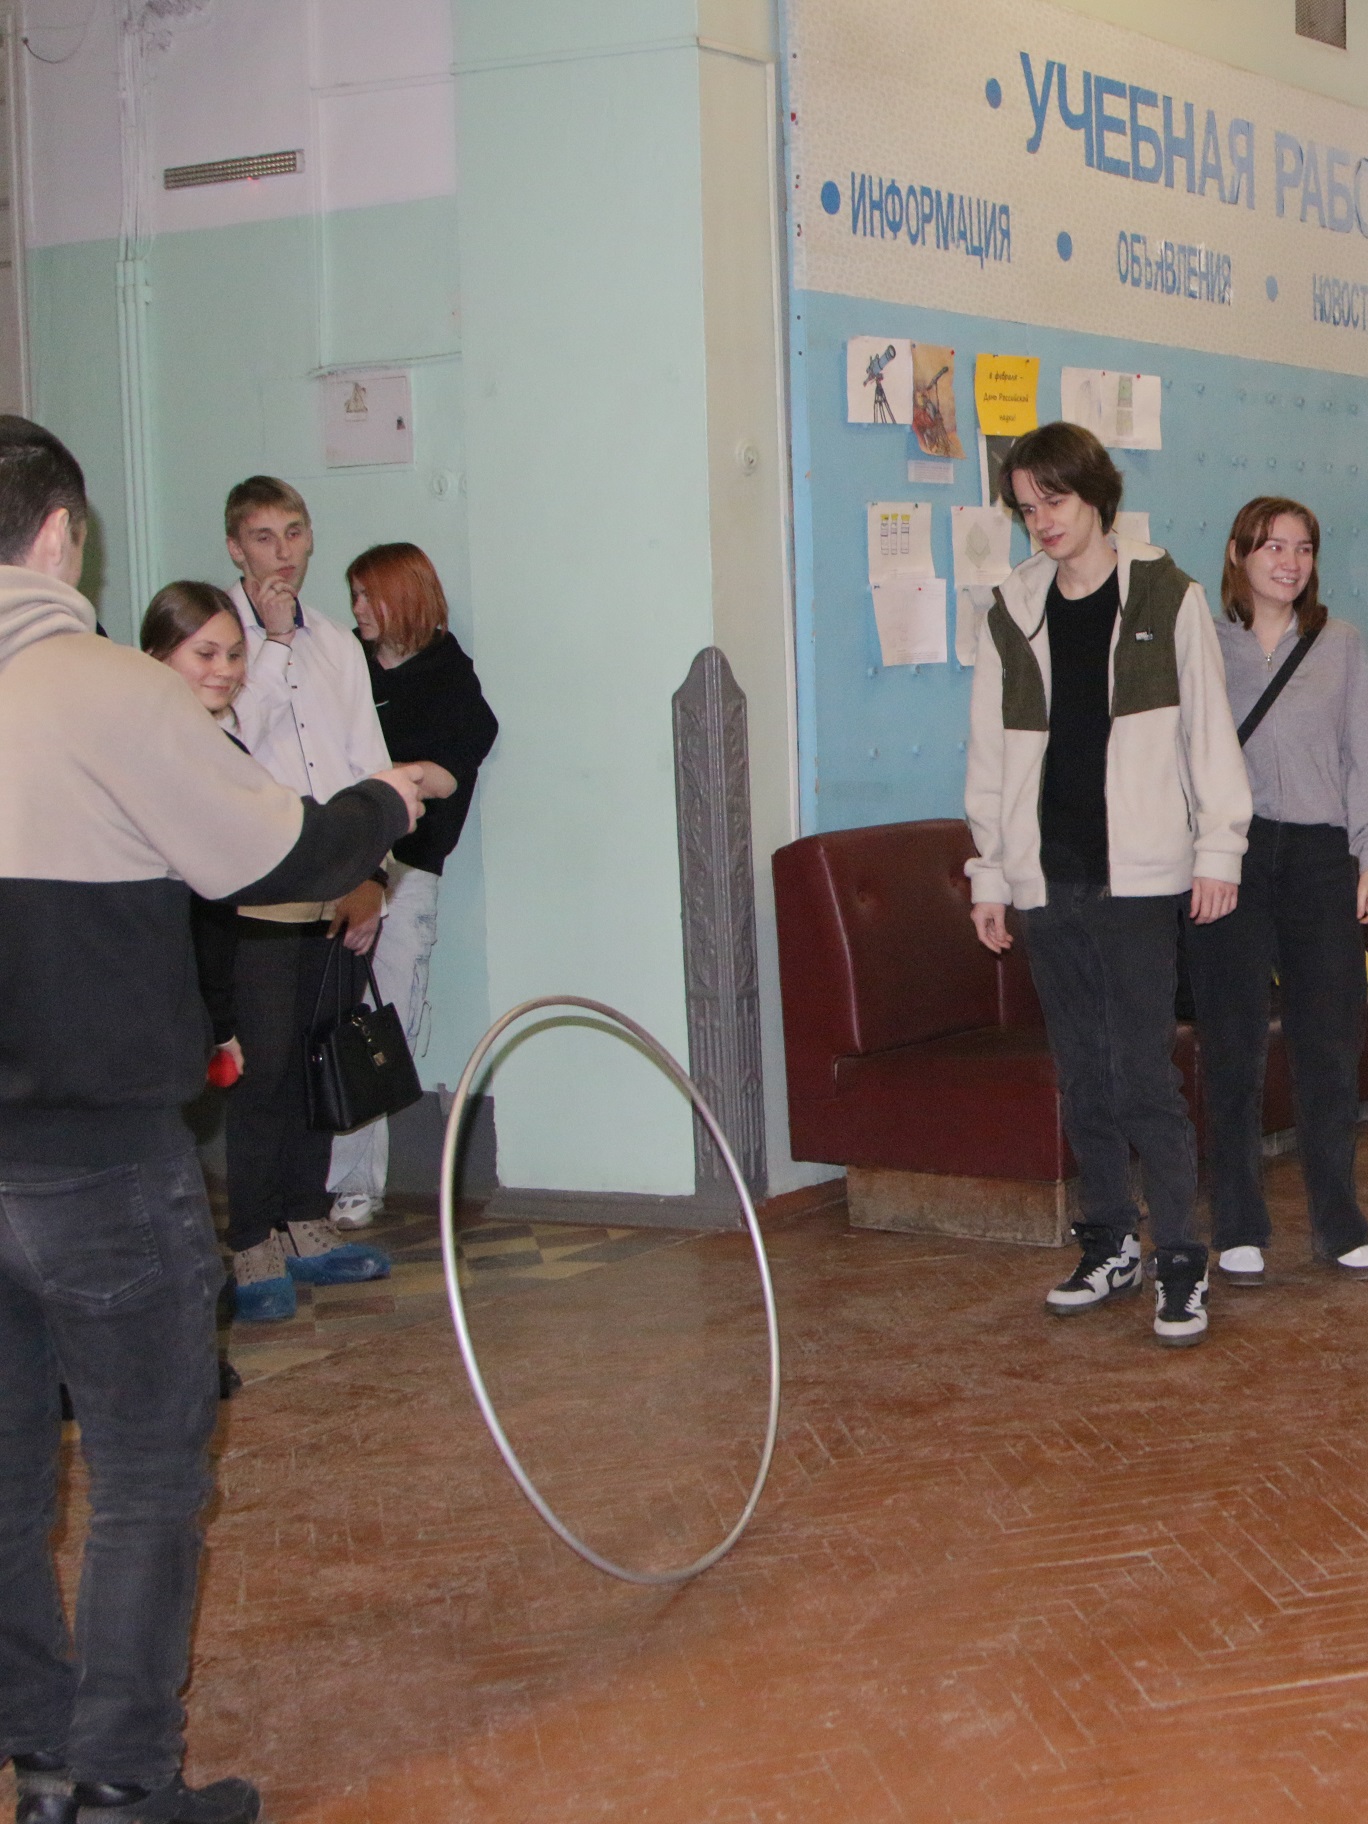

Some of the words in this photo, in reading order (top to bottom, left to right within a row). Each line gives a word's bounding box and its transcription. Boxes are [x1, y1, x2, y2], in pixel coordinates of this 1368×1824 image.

[1019, 51, 1256, 211] УЧЕБНАЯ
[850, 171, 1012, 270] ИНФОРМАЦИЯ
[1117, 230, 1232, 306] ОБЪЯВЛЕНИЯ
